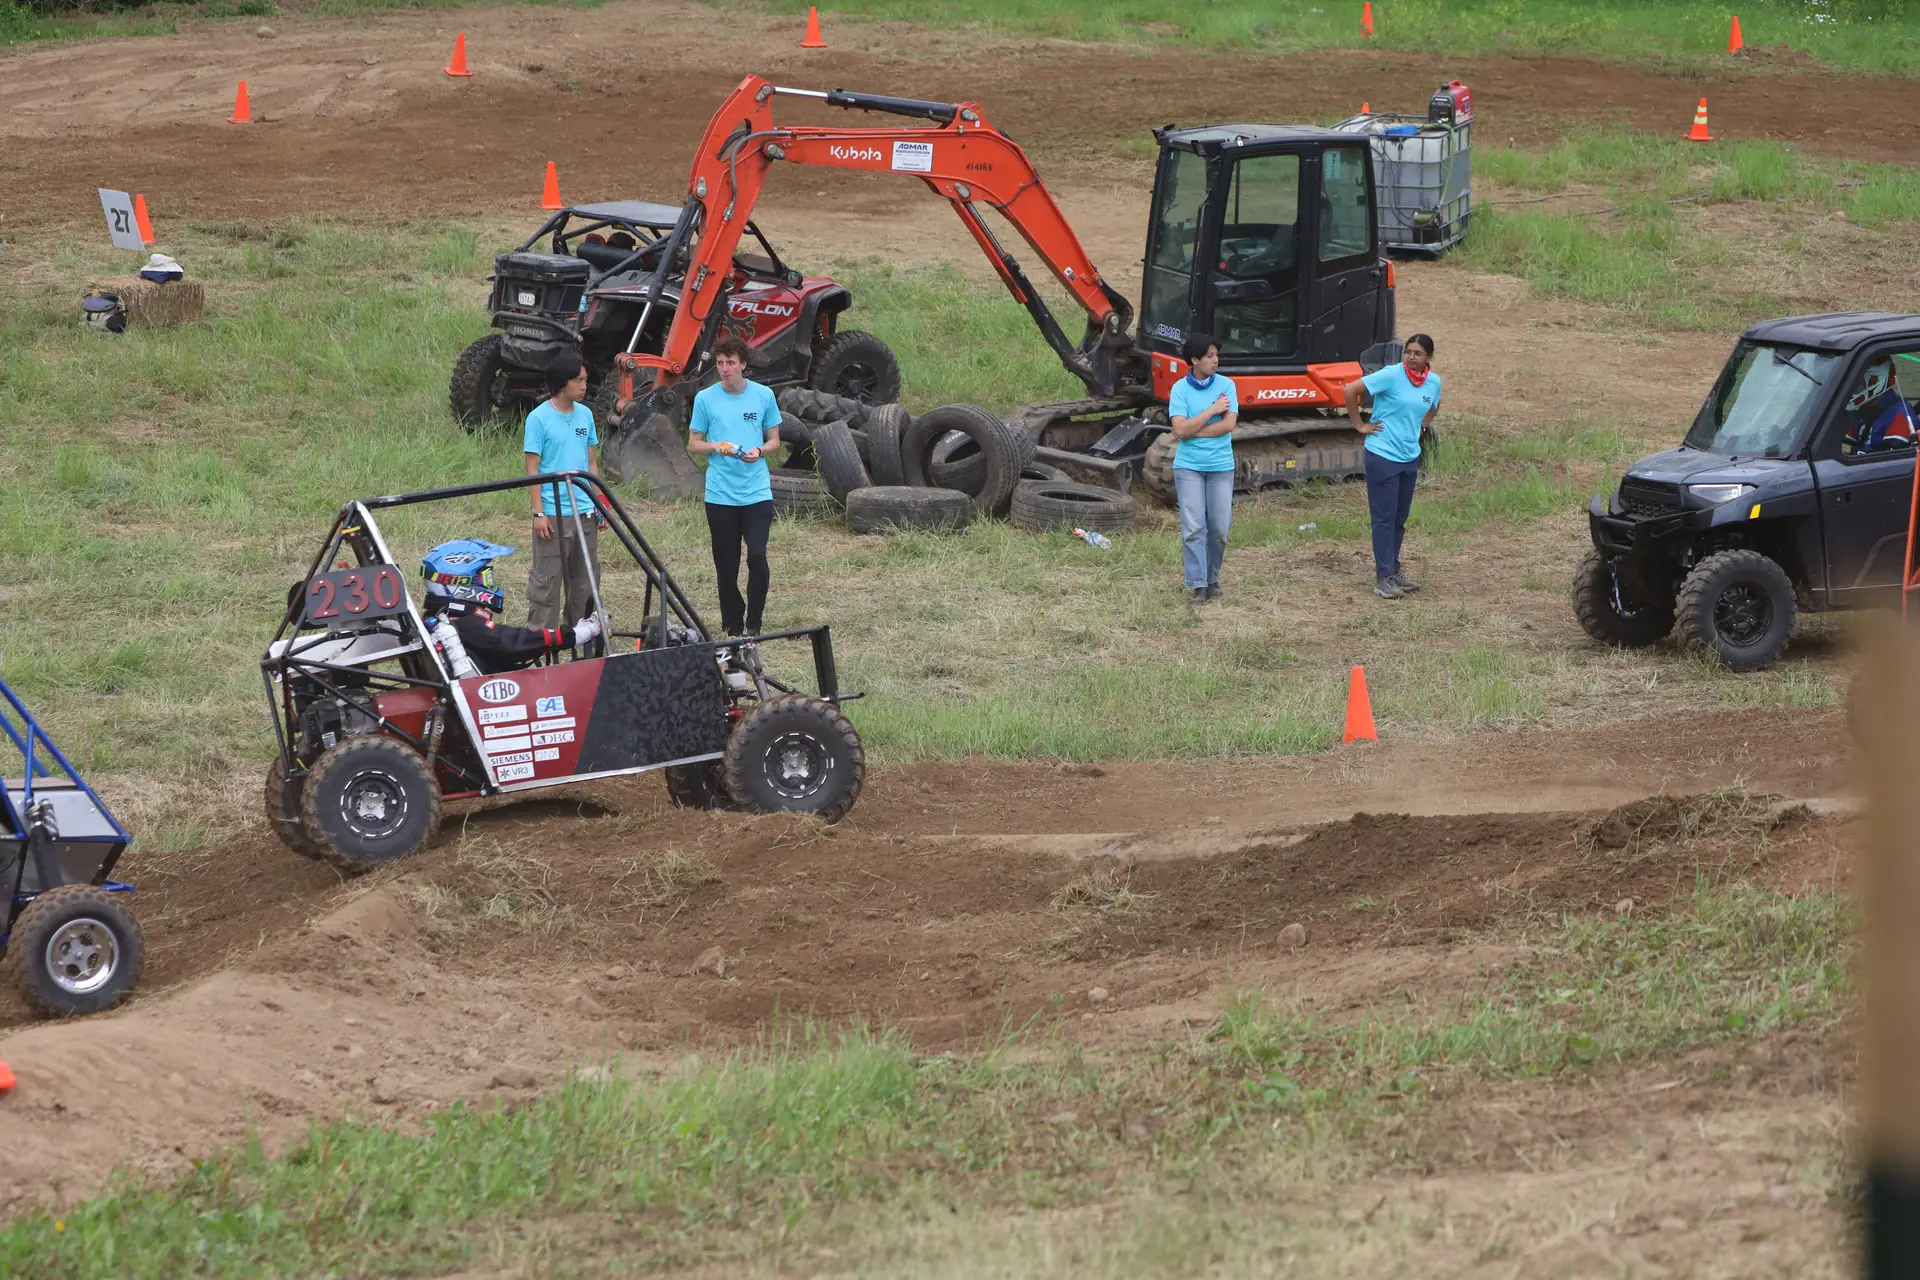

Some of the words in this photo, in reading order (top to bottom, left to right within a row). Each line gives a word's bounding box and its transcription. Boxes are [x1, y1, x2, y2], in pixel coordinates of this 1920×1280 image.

[830, 145, 882, 161] Kubota
[898, 143, 928, 151] ADMAR
[110, 207, 131, 234] 27
[727, 300, 794, 317] TALON
[513, 325, 545, 337] HONDA
[743, 412, 757, 421] SAE
[575, 427, 588, 436] SAE
[311, 569, 401, 620] 230
[453, 586, 495, 605] FXR
[537, 697, 564, 713] SAE
[490, 753, 531, 766] SIEMENS
[511, 767, 529, 776] VR3
